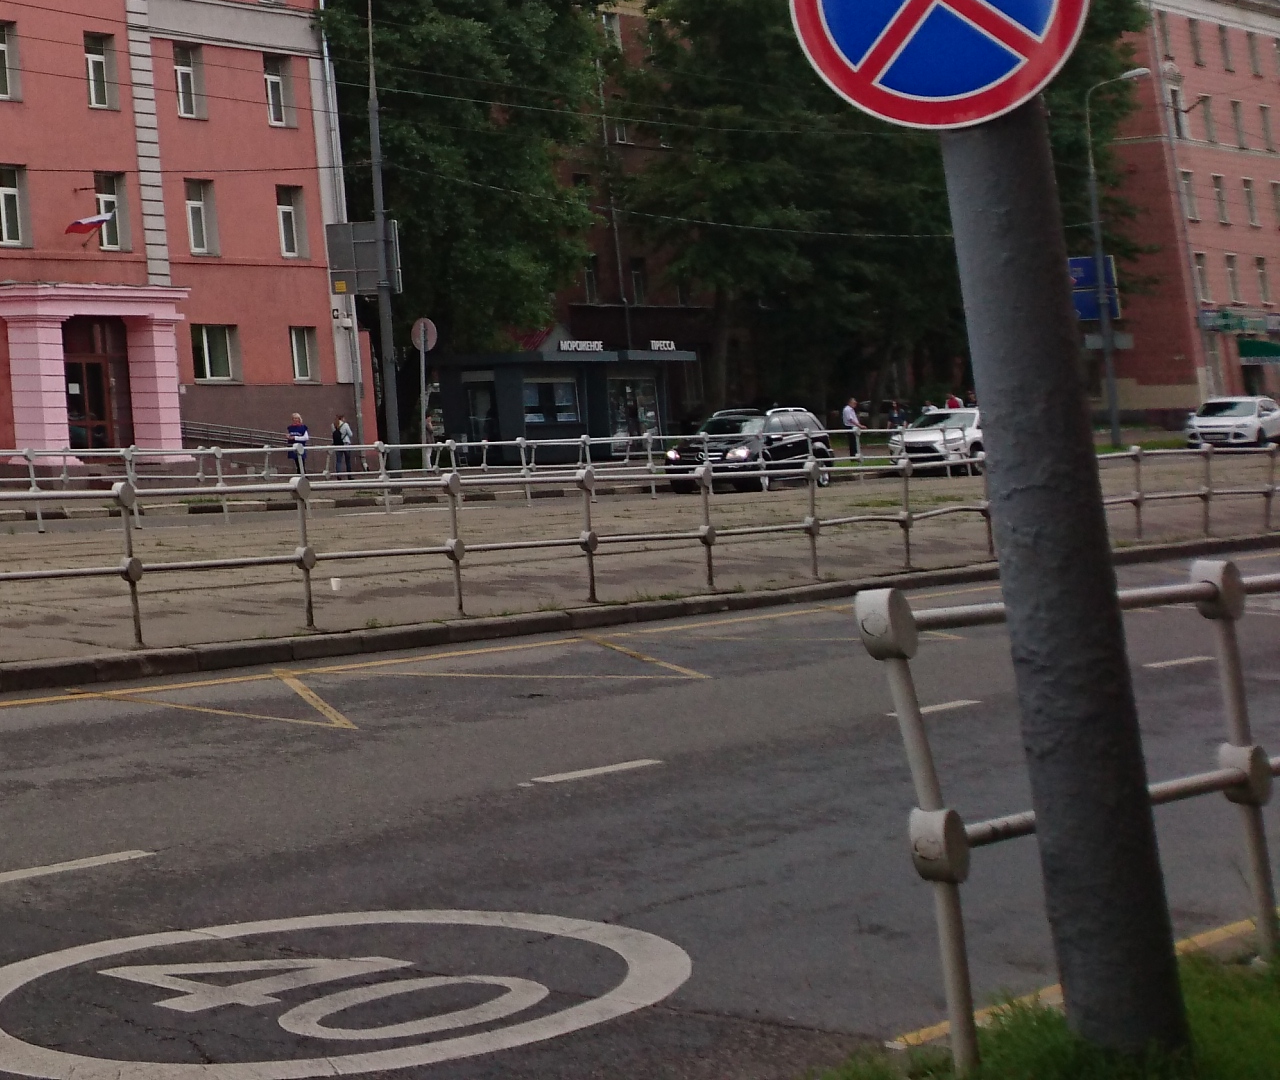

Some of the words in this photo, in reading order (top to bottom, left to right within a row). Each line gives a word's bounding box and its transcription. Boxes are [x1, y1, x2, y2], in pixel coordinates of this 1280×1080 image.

[560, 340, 604, 351] МОРОЖЕНОЕ
[650, 340, 676, 351] ПРЕССА
[95, 955, 550, 1041] 40
